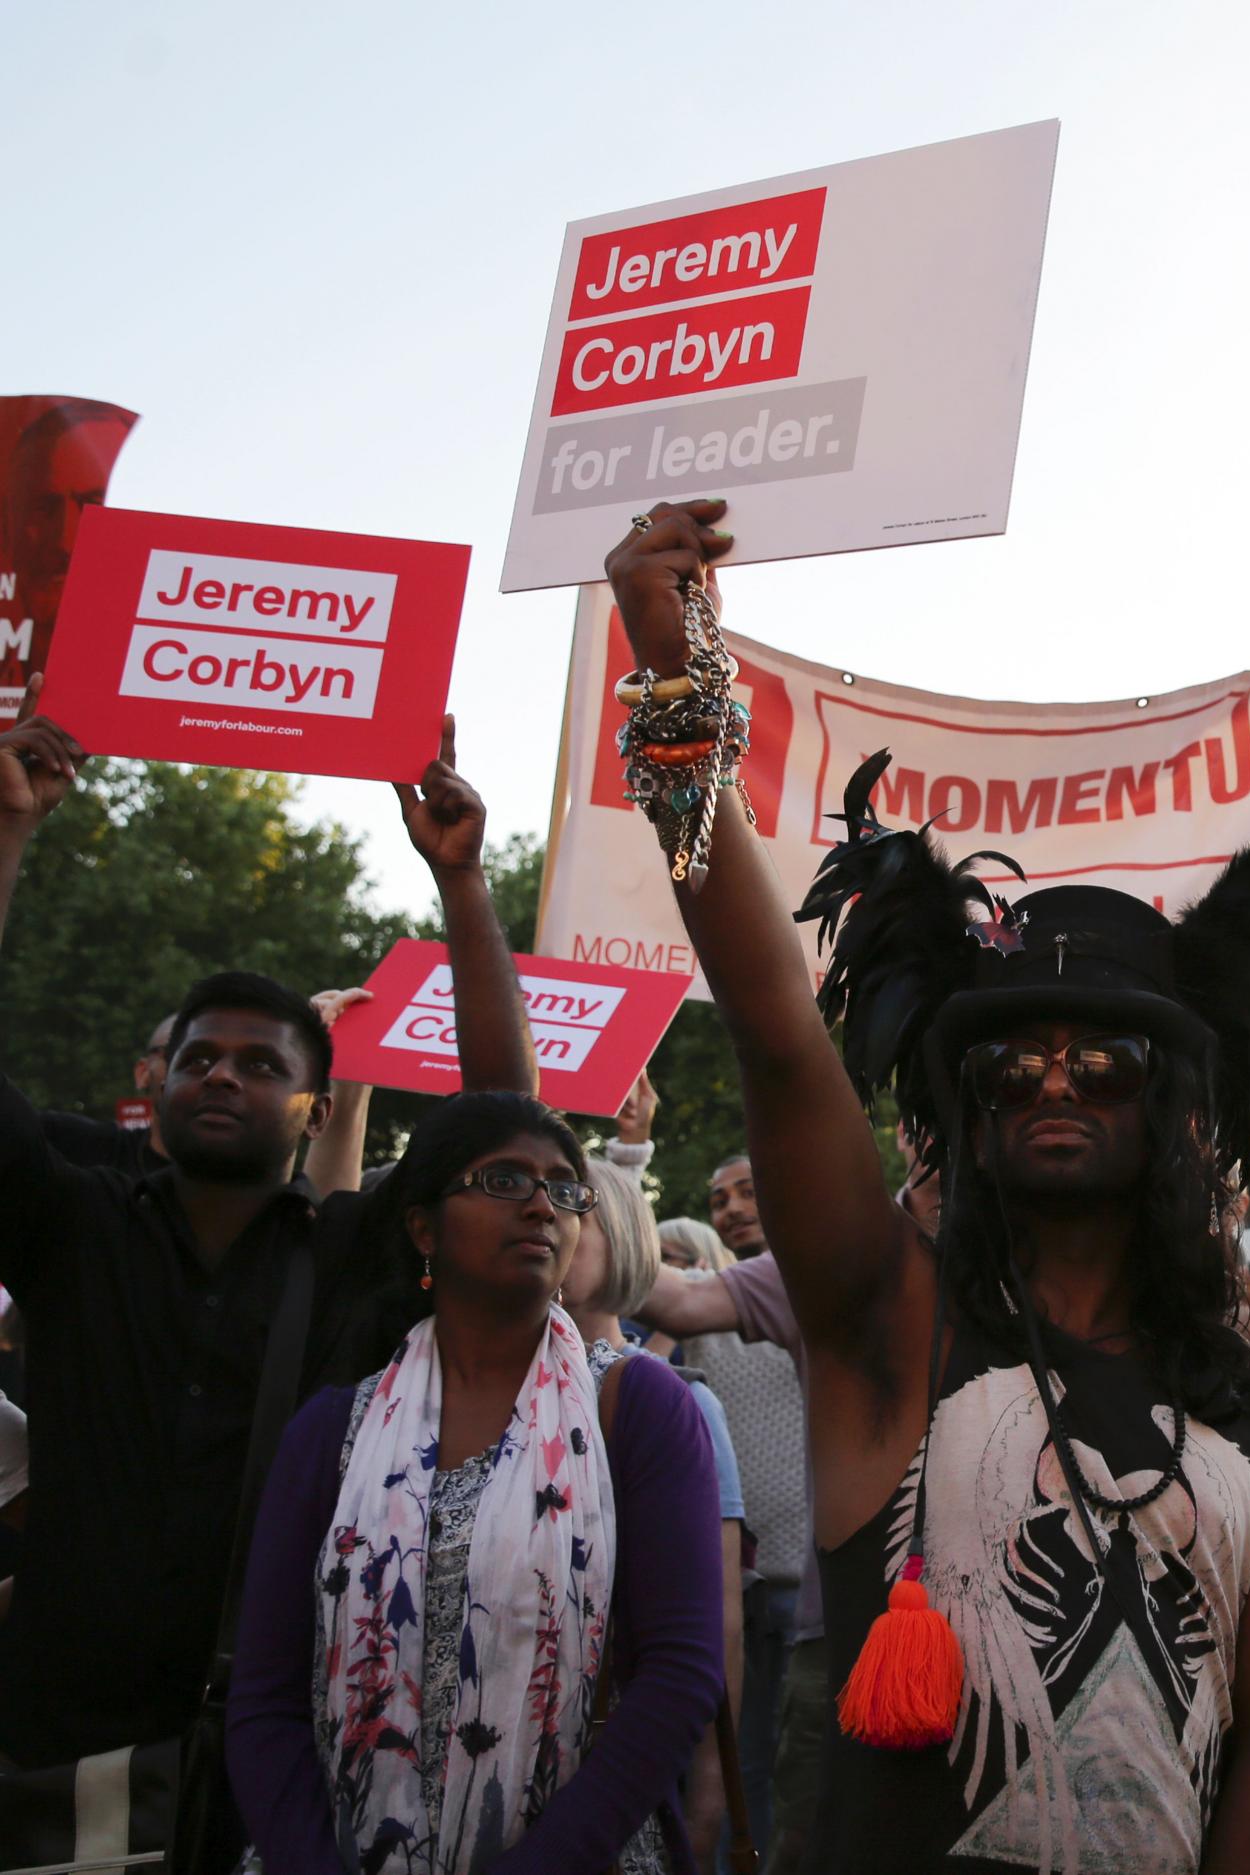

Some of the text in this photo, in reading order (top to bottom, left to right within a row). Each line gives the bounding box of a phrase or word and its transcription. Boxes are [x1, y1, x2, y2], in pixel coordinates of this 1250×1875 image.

[585, 223, 798, 300] Jeremy
[571, 321, 775, 392] Corbyn
[550, 409, 841, 494] for leader.
[156, 566, 375, 633] Jeremy
[142, 640, 356, 704] Corbyn
[179, 715, 304, 737] jeremyforlabour.com
